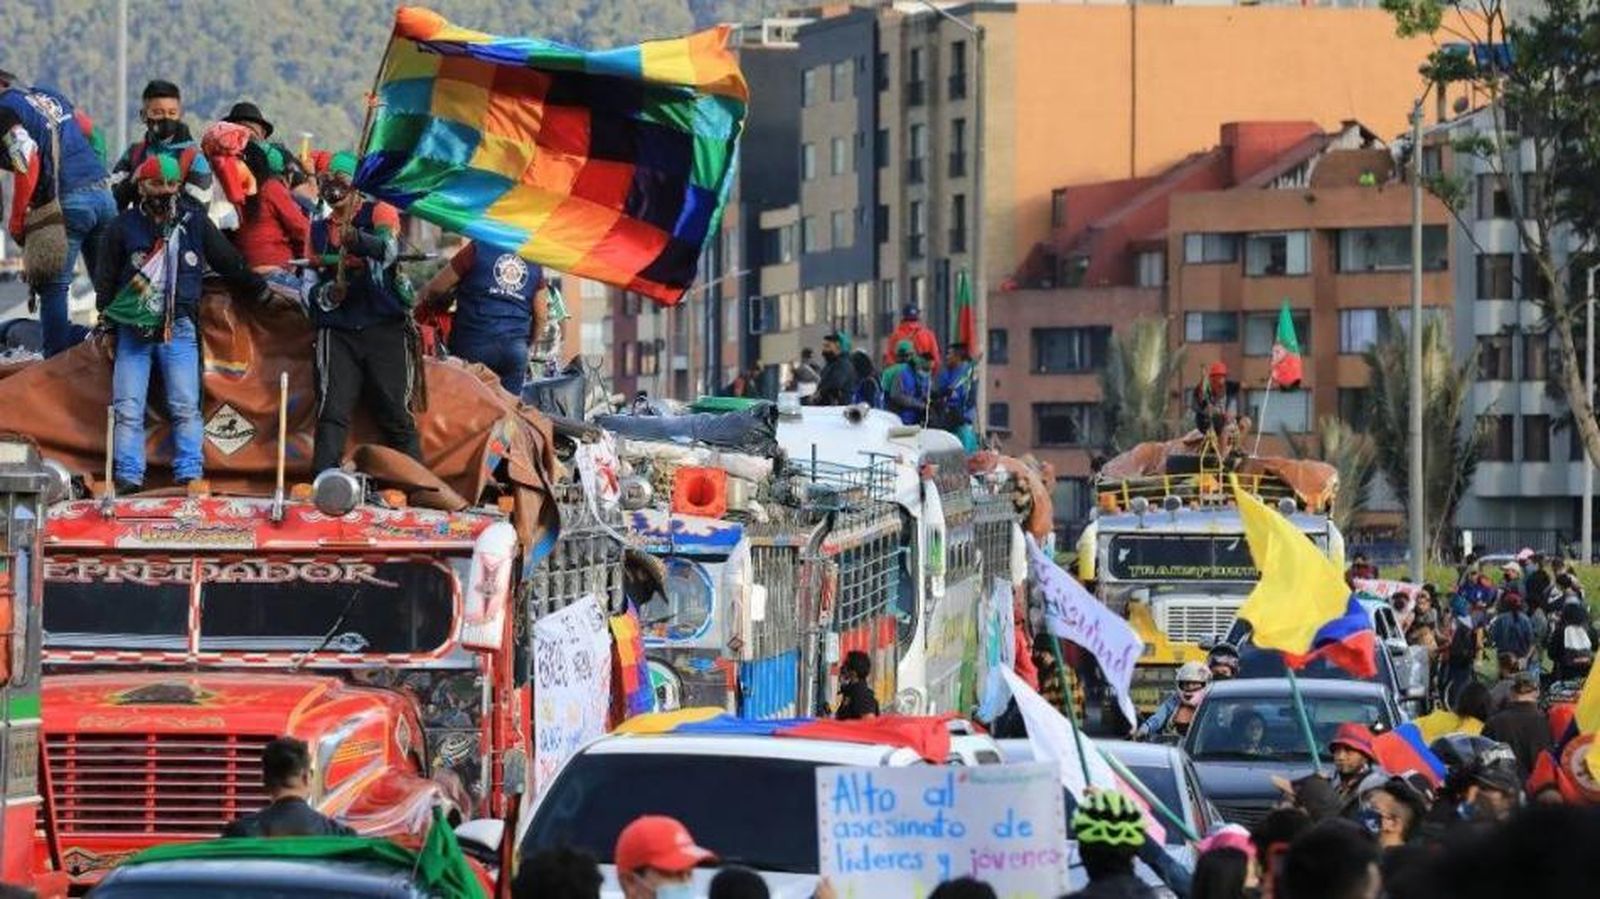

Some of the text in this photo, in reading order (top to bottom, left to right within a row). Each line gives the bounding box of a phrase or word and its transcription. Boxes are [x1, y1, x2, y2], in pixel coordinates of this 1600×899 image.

[832, 770, 955, 814] Alto al
[832, 807, 1033, 838] asesinato de
[937, 853, 950, 882] y
